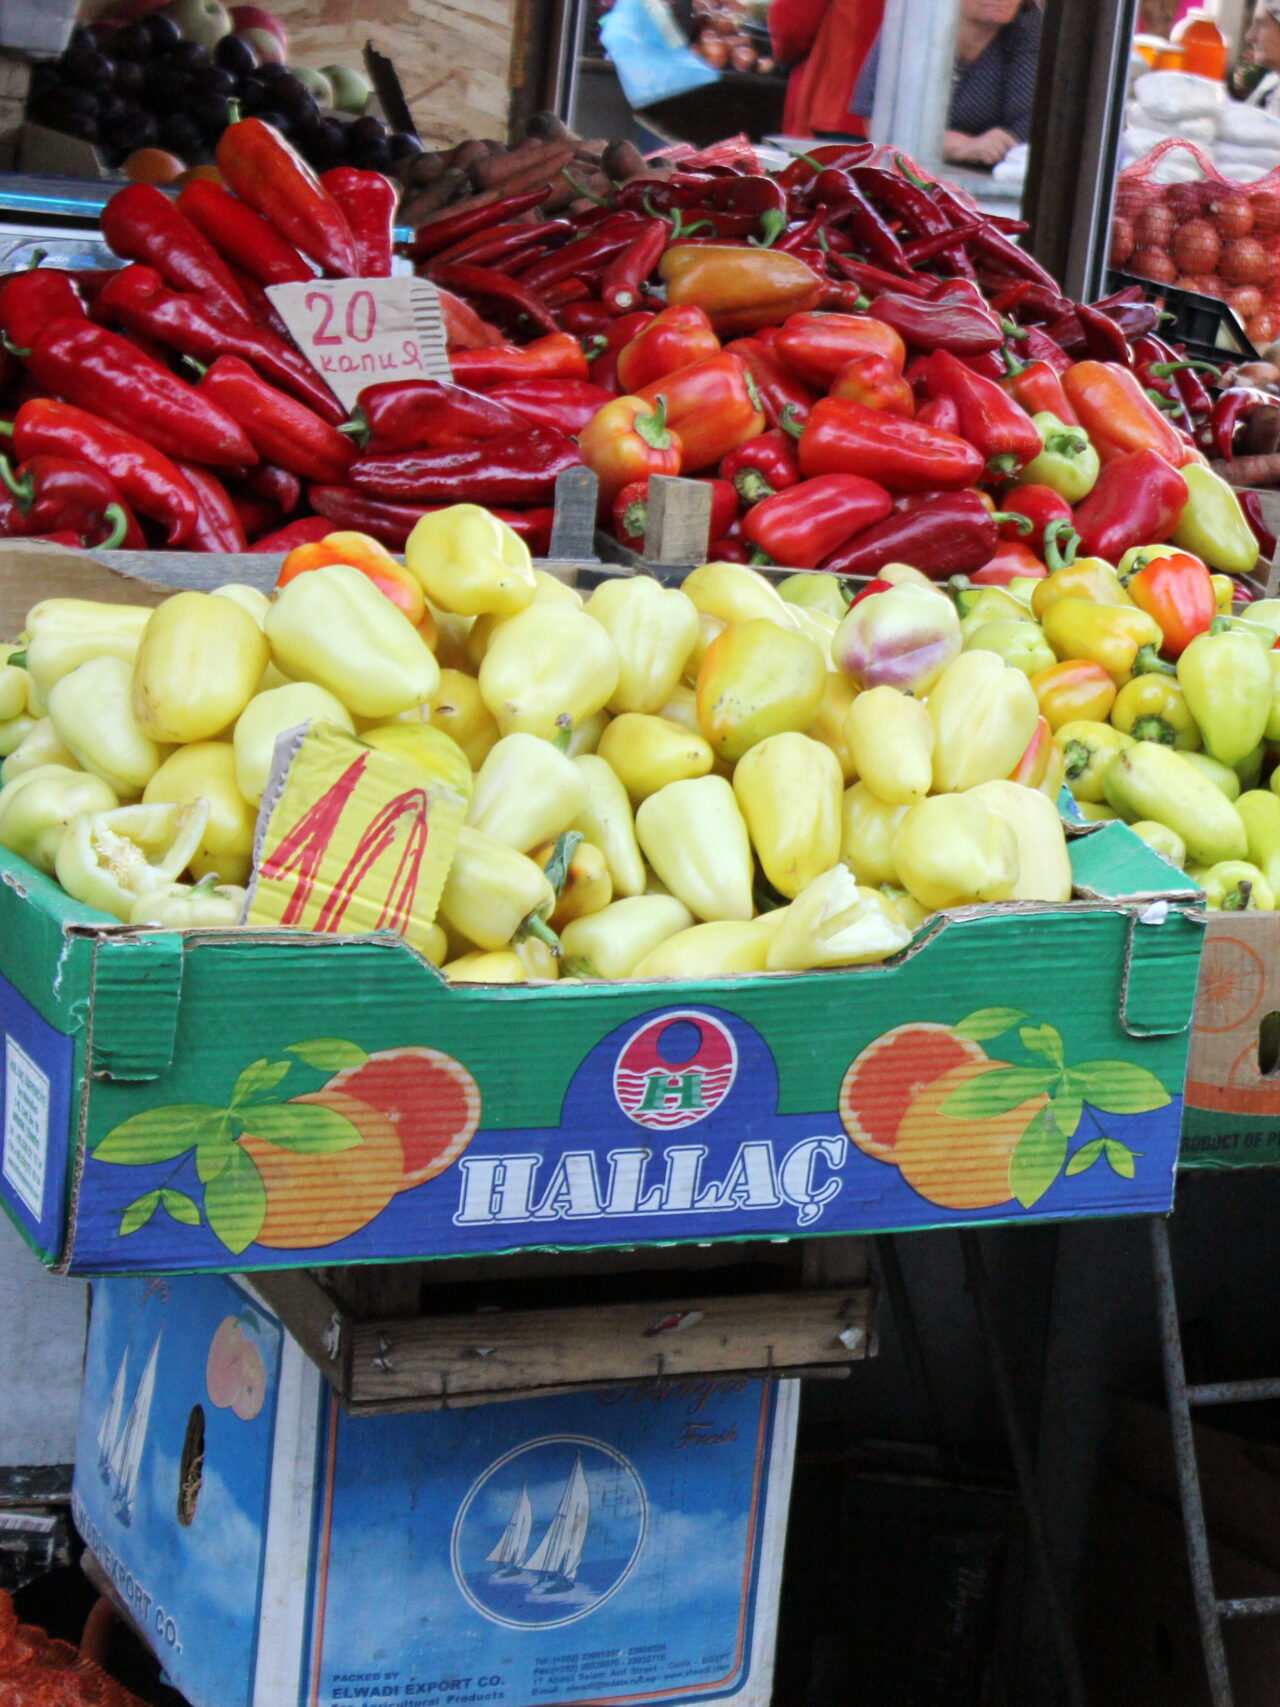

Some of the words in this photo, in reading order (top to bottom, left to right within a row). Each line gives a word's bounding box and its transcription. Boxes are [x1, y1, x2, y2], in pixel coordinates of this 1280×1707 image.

[305, 290, 377, 347] 20
[320, 340, 424, 373] капия
[258, 750, 428, 936] 10
[1180, 1134, 1239, 1149] RODUCT
[1243, 1132, 1263, 1147] OF
[453, 1134, 847, 1227] HALLAÇ
[103, 1548, 153, 1621] EXPORT
[154, 1605, 184, 1657] CO.
[701, 1652, 731, 1665] EGYPT
[332, 1672, 381, 1683] PACKED
[383, 1671, 401, 1681] BY
[332, 1685, 400, 1700] ELWADI
[404, 1677, 474, 1696] EXPORT
[476, 1674, 506, 1688] CO.
[446, 1690, 505, 1705] Products
